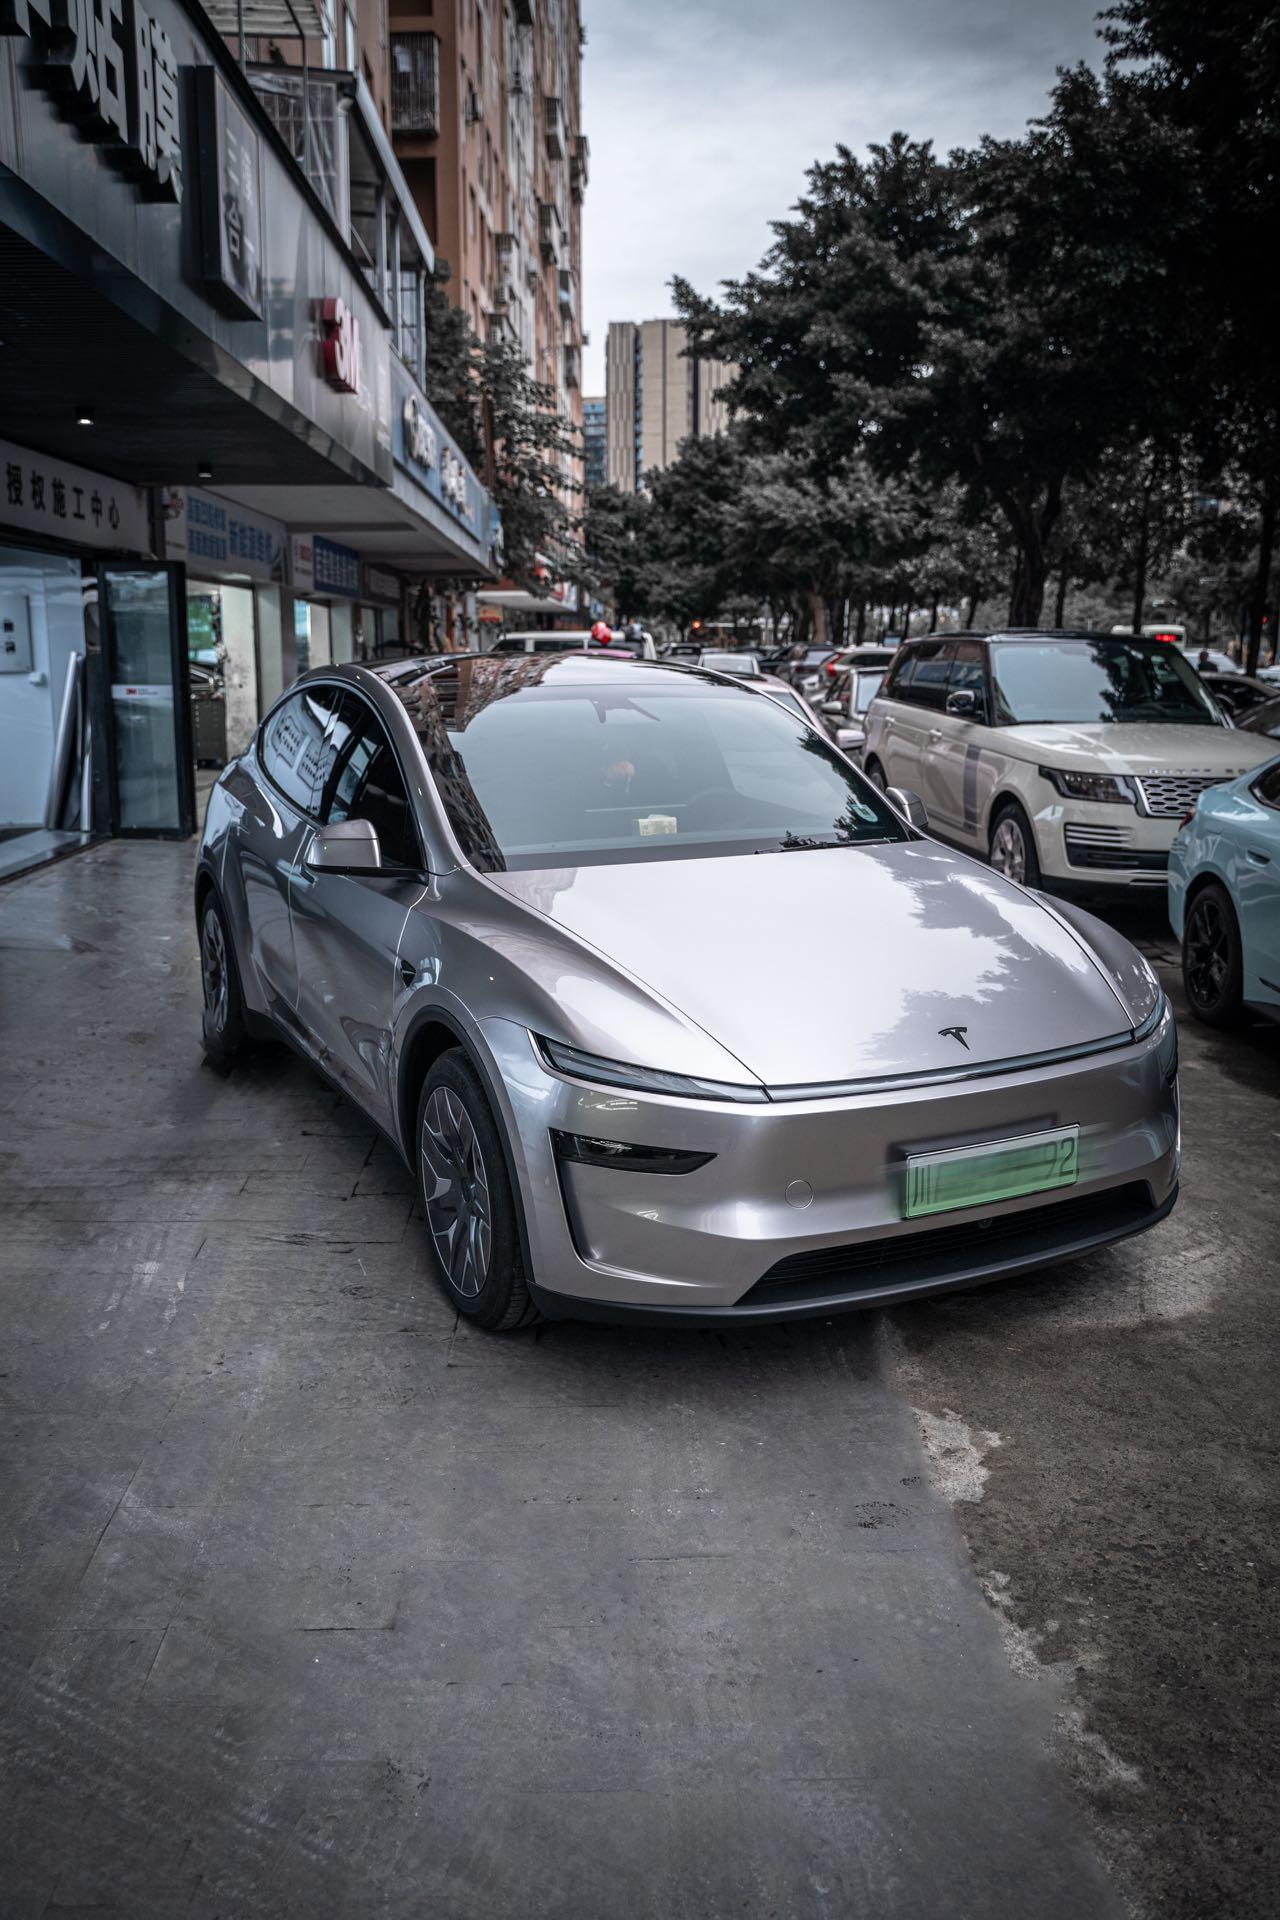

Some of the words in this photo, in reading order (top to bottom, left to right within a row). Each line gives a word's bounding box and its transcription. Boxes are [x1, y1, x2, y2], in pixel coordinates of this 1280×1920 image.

[14, 0, 184, 205] 贴膜
[6, 462, 120, 530] 授权施工中心
